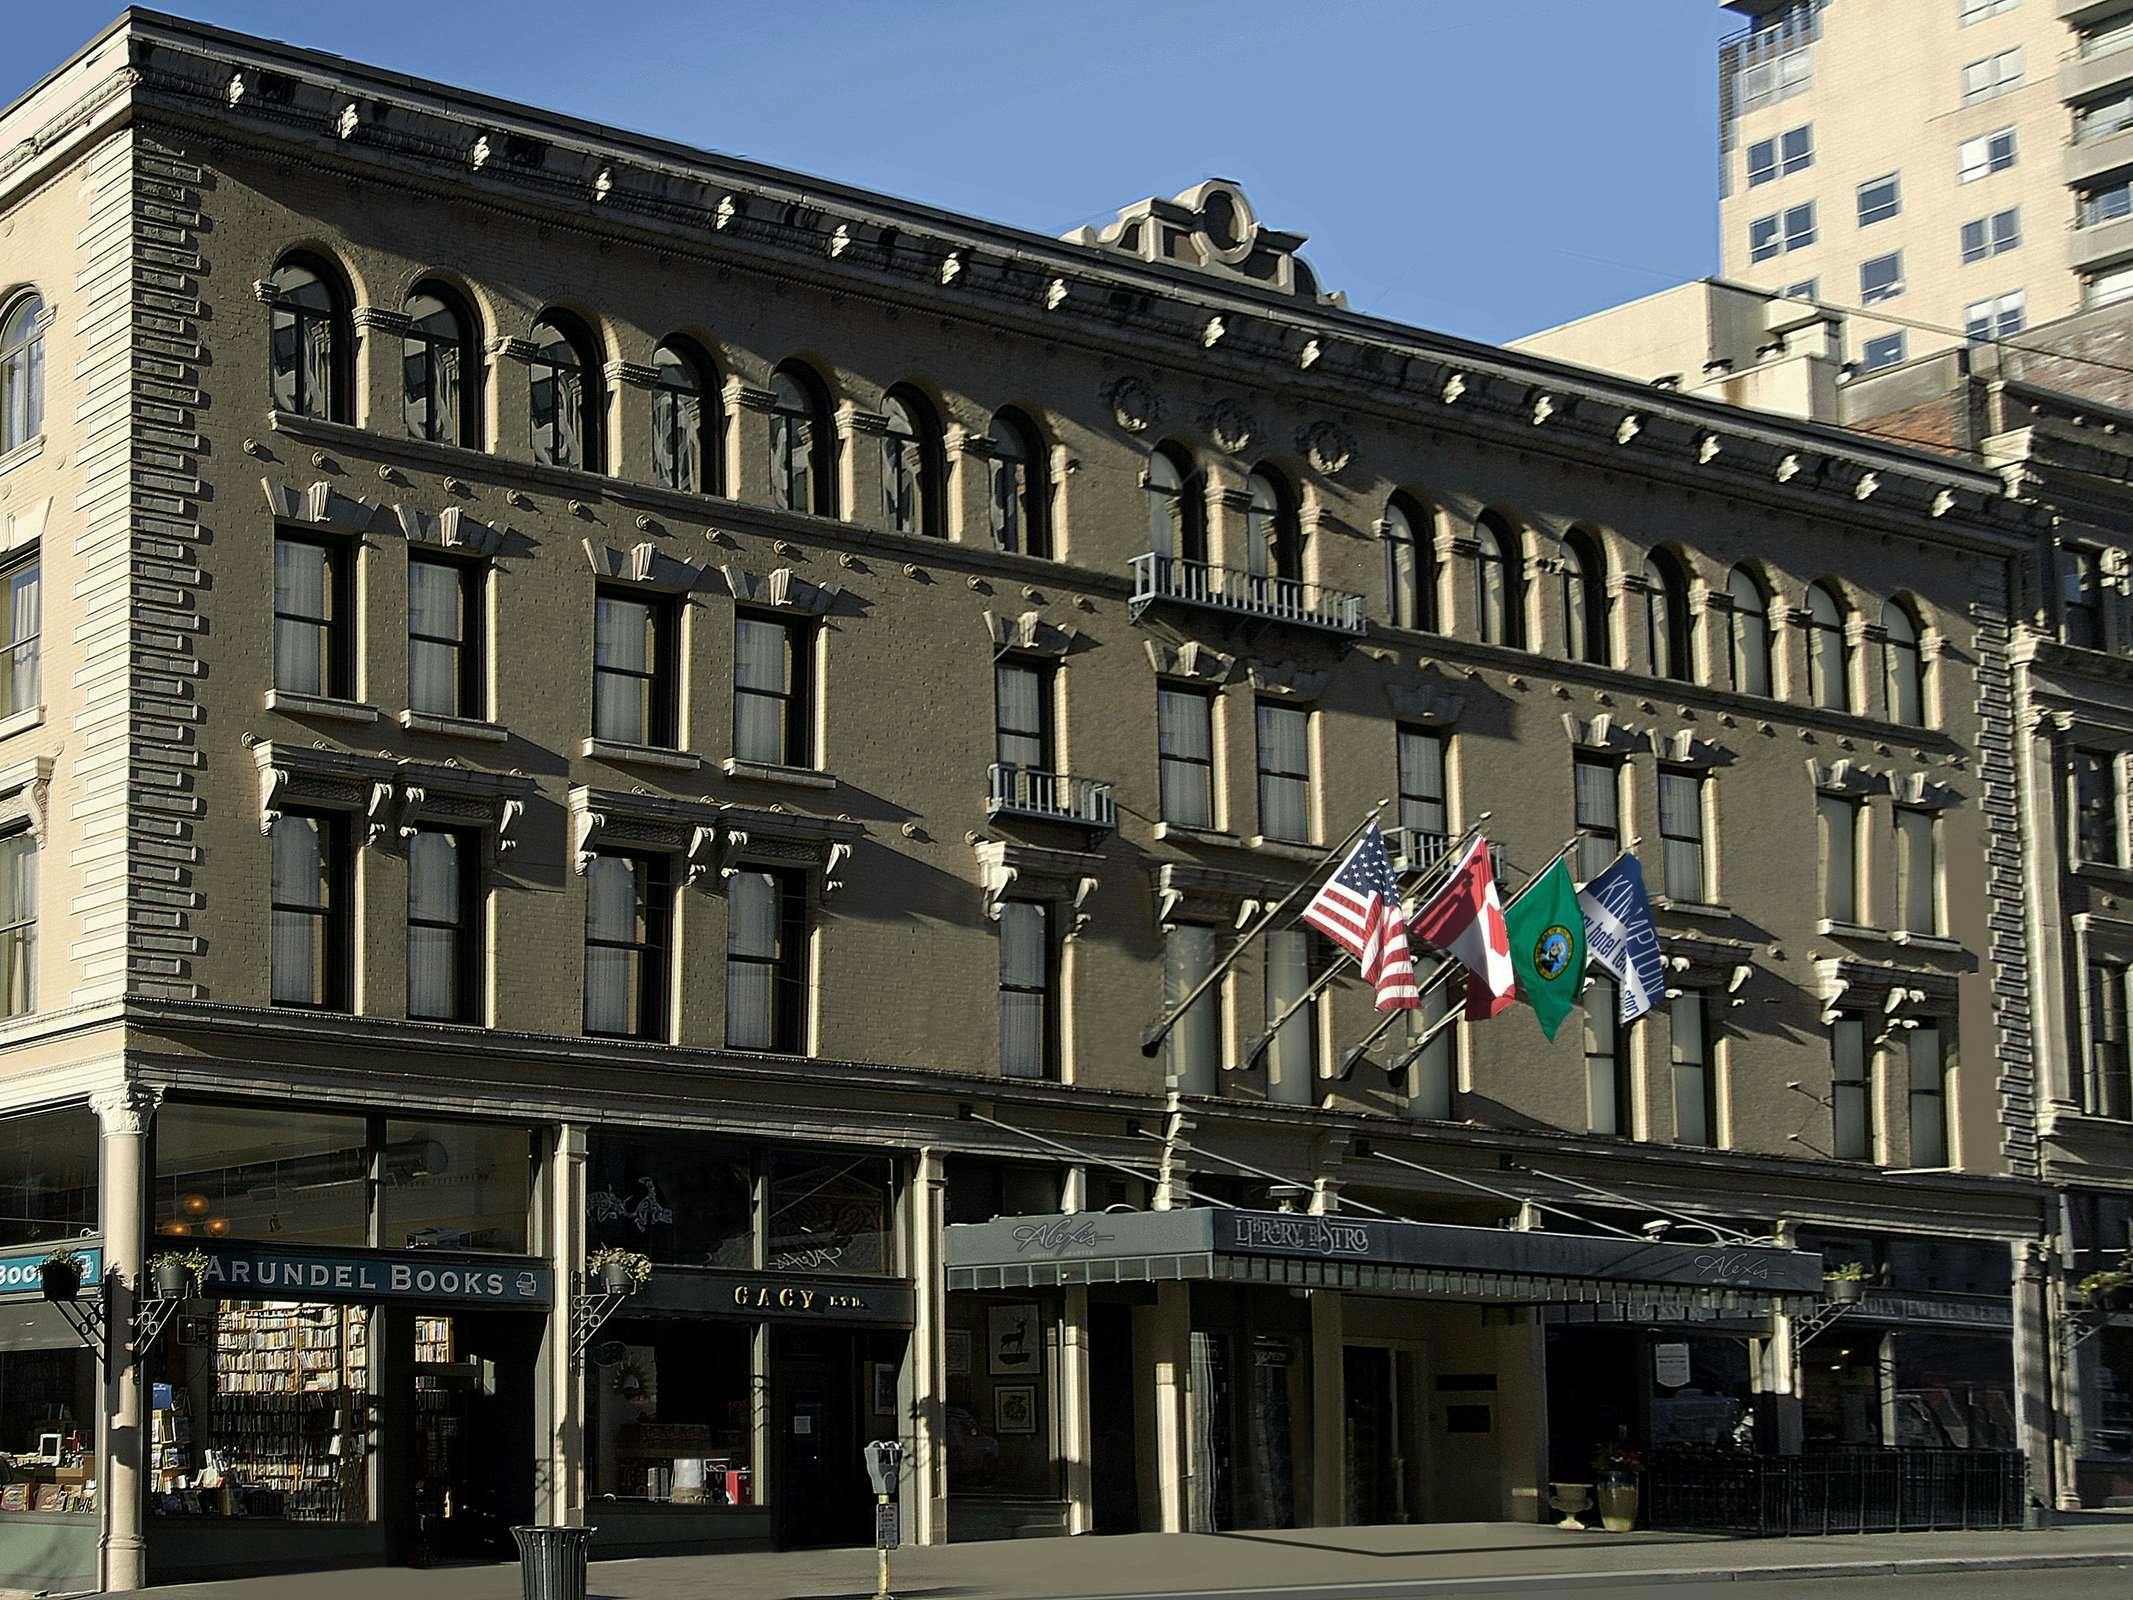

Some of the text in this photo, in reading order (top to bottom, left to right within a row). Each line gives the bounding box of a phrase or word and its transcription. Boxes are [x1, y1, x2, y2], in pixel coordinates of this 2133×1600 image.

[1587, 922, 1621, 958] hotel
[1013, 1218, 1114, 1256] Alexis
[1308, 1218, 1369, 1255] BISTRO
[0, 1264, 42, 1286] BOO
[204, 1256, 504, 1295] ARUNDEL BOOKS
[1694, 1253, 1784, 1279] Alexis
[735, 1286, 815, 1309] GACY
